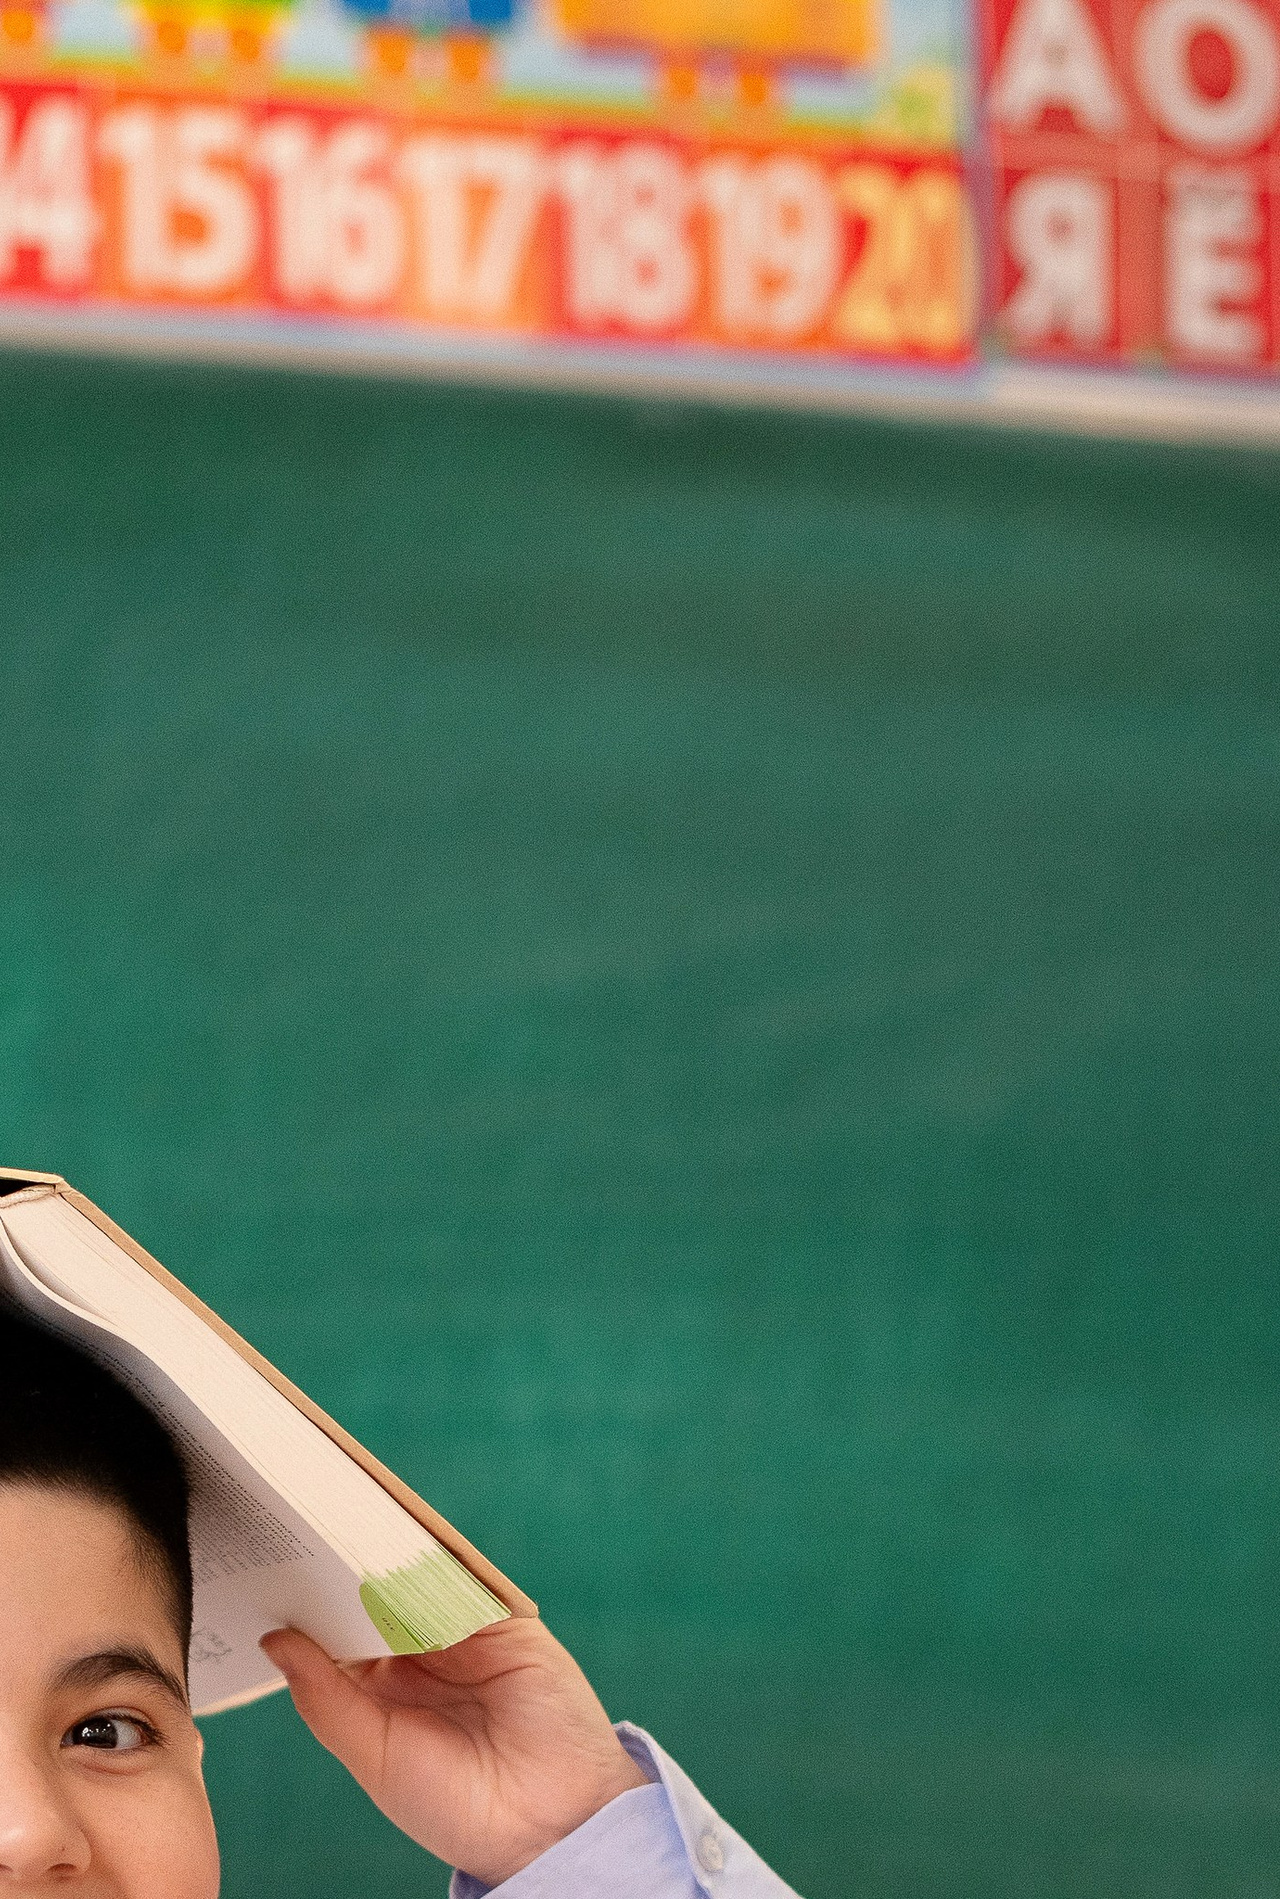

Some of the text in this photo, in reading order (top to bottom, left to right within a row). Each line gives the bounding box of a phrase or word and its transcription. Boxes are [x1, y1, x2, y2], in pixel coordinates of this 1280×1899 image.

[992, 0, 1280, 148] А О
[100, 104, 258, 292] 15
[255, 112, 408, 306] 16
[400, 130, 538, 318] 17
[550, 142, 698, 330] 18
[698, 152, 838, 334] 19
[1003, 174, 1116, 345] Я
